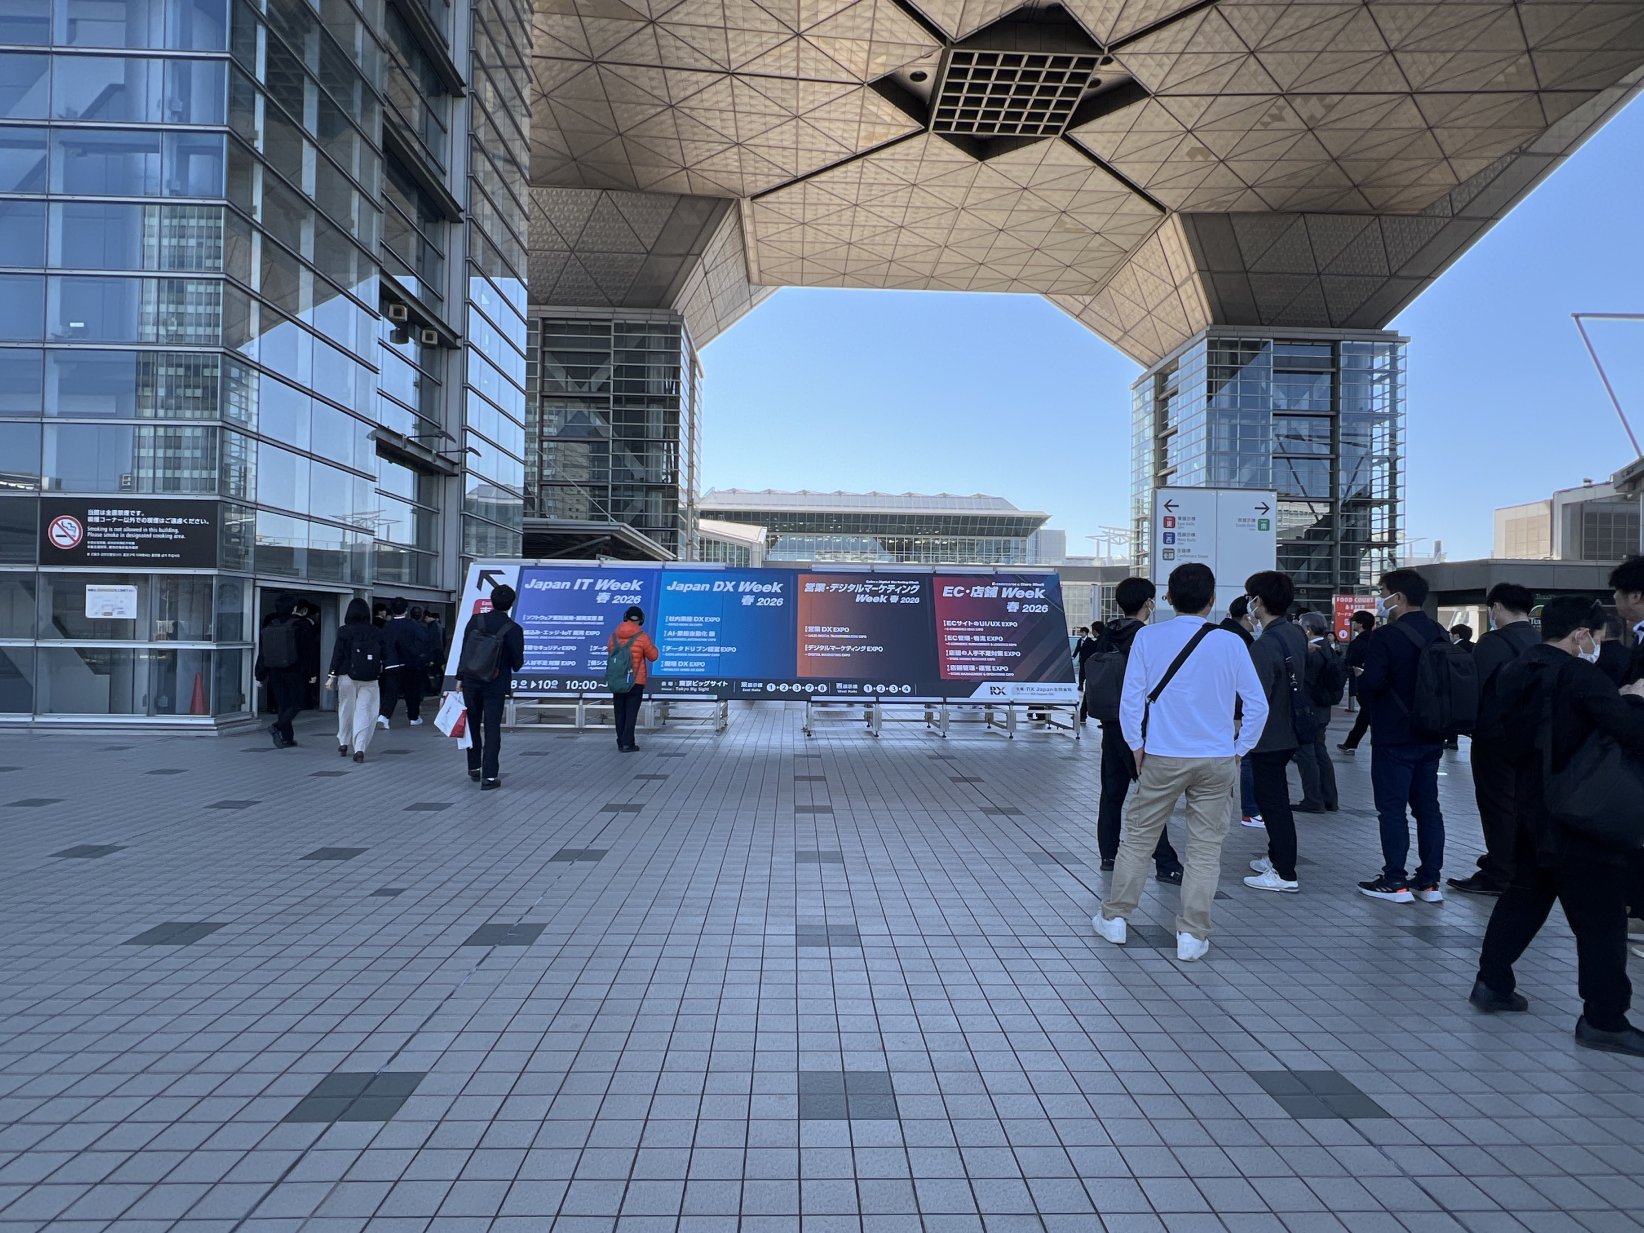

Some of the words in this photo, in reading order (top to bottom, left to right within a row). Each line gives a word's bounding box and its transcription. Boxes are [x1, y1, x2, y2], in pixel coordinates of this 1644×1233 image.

[524, 579, 571, 591] Japan
[574, 579, 594, 590] IT
[594, 579, 644, 591] Week
[666, 581, 710, 592] Japan
[712, 581, 736, 592] DX
[738, 582, 783, 593] Week
[804, 583, 920, 594] 営業・デジタルマーケティング
[596, 592, 611, 604] 春
[612, 596, 641, 604] 2026
[943, 586, 999, 598] EC・店舗
[1001, 587, 1046, 599] Week
[741, 595, 755, 606] 春
[756, 598, 784, 606] 2026
[856, 595, 888, 603] Week
[890, 595, 899, 603] 春
[1007, 601, 1020, 612] 春
[1022, 604, 1049, 613] 2026
[538, 680, 551, 689] 10
[990, 686, 1006, 695] RX
